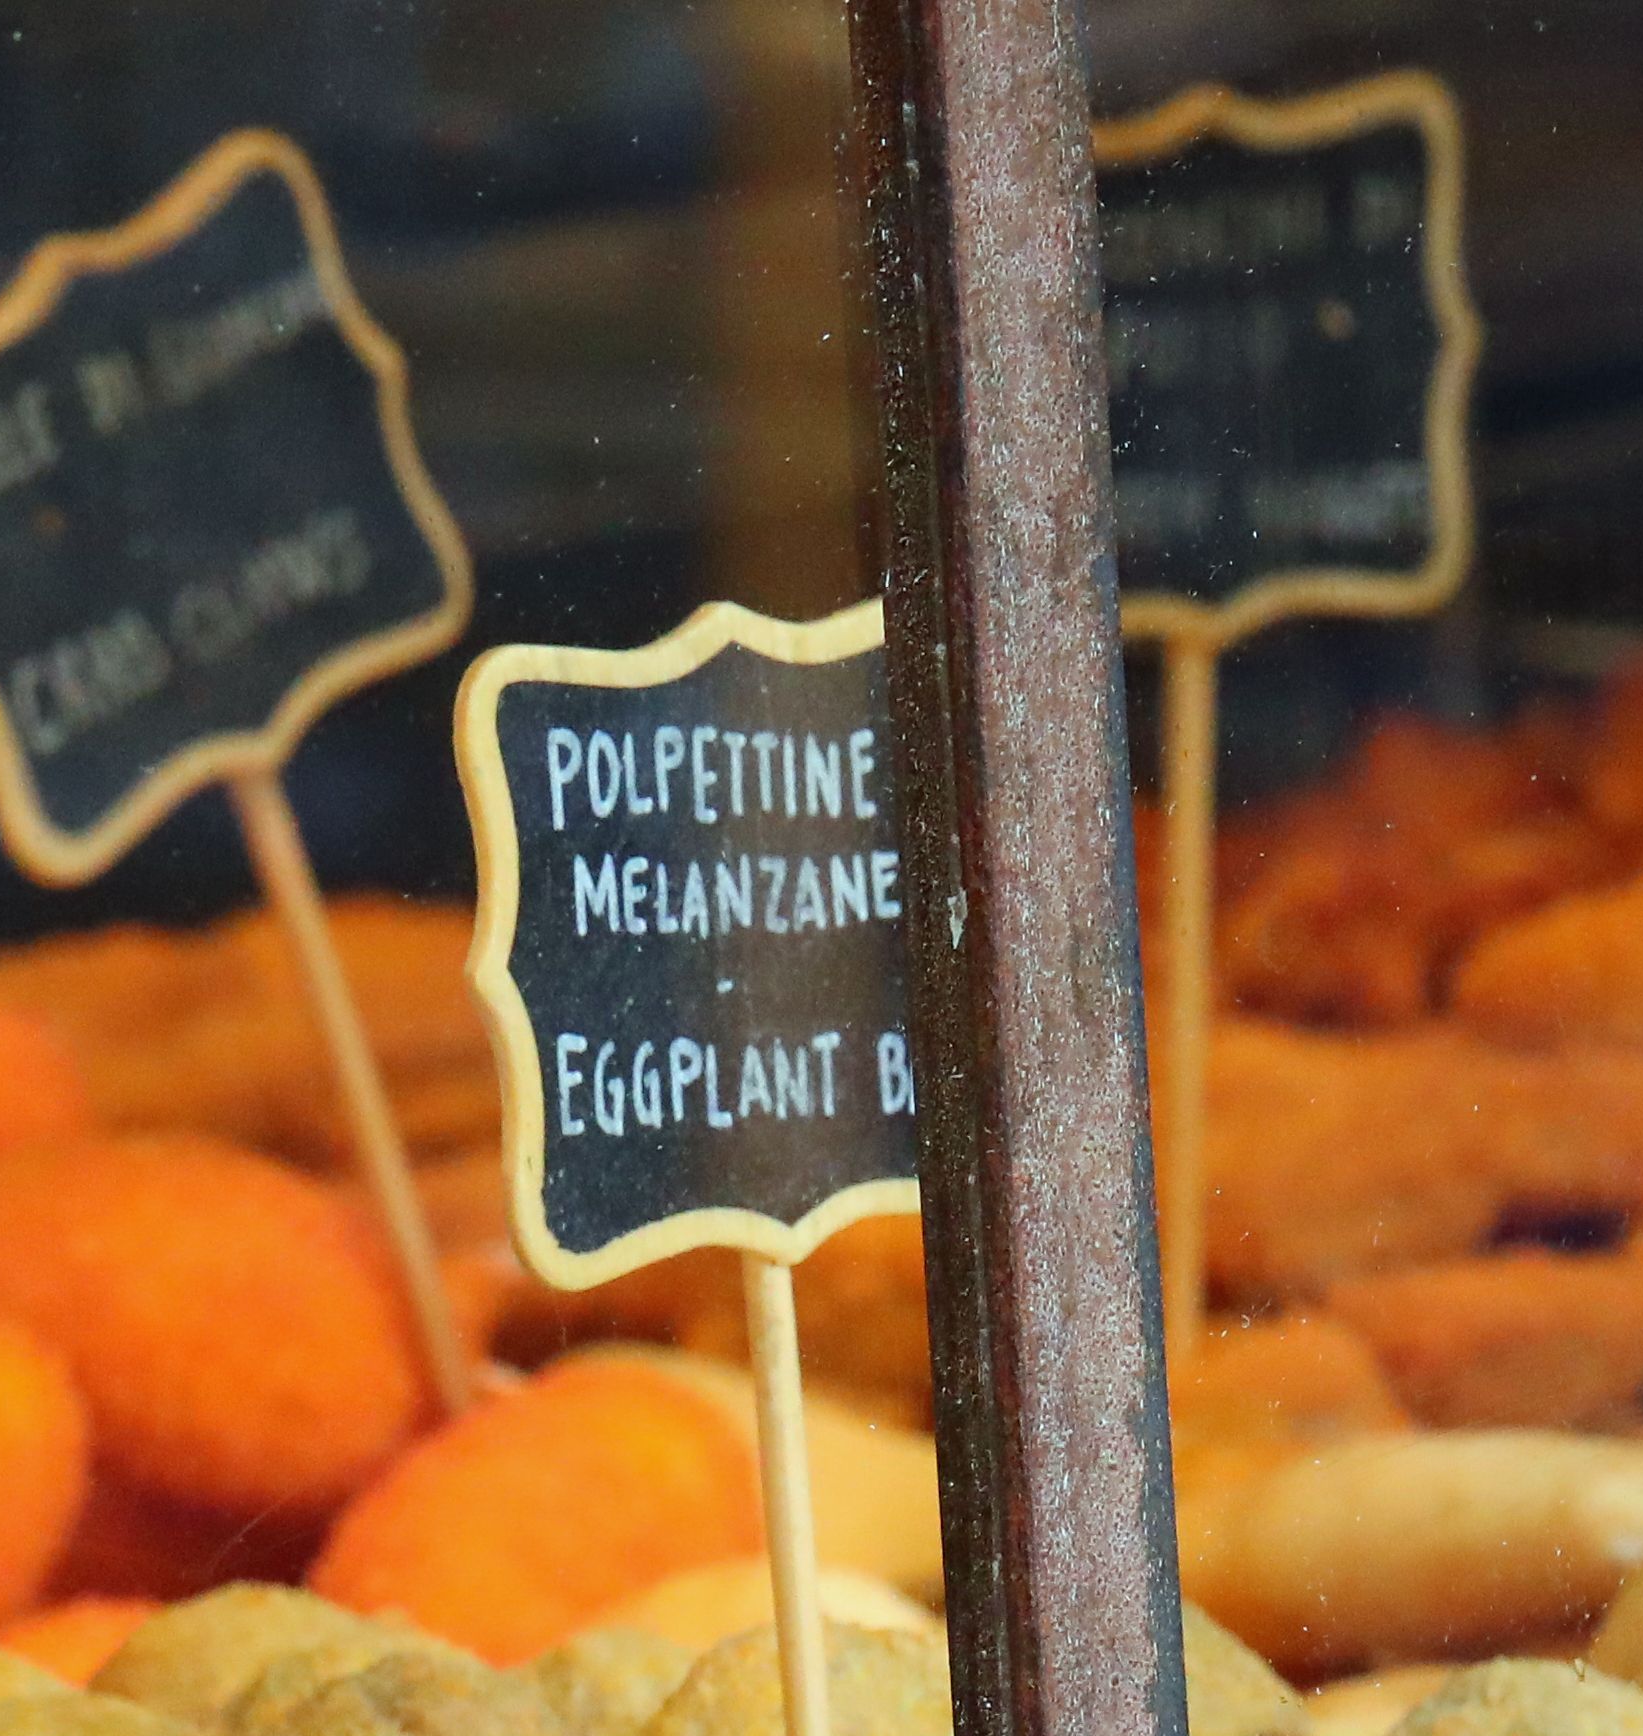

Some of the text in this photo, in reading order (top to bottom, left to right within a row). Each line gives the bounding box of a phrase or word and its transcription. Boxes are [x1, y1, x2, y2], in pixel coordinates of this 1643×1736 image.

[547, 726, 878, 831] POLPETTINE
[573, 849, 901, 938] MELANZANE
[555, 1031, 915, 1137] EGGPLANT B
